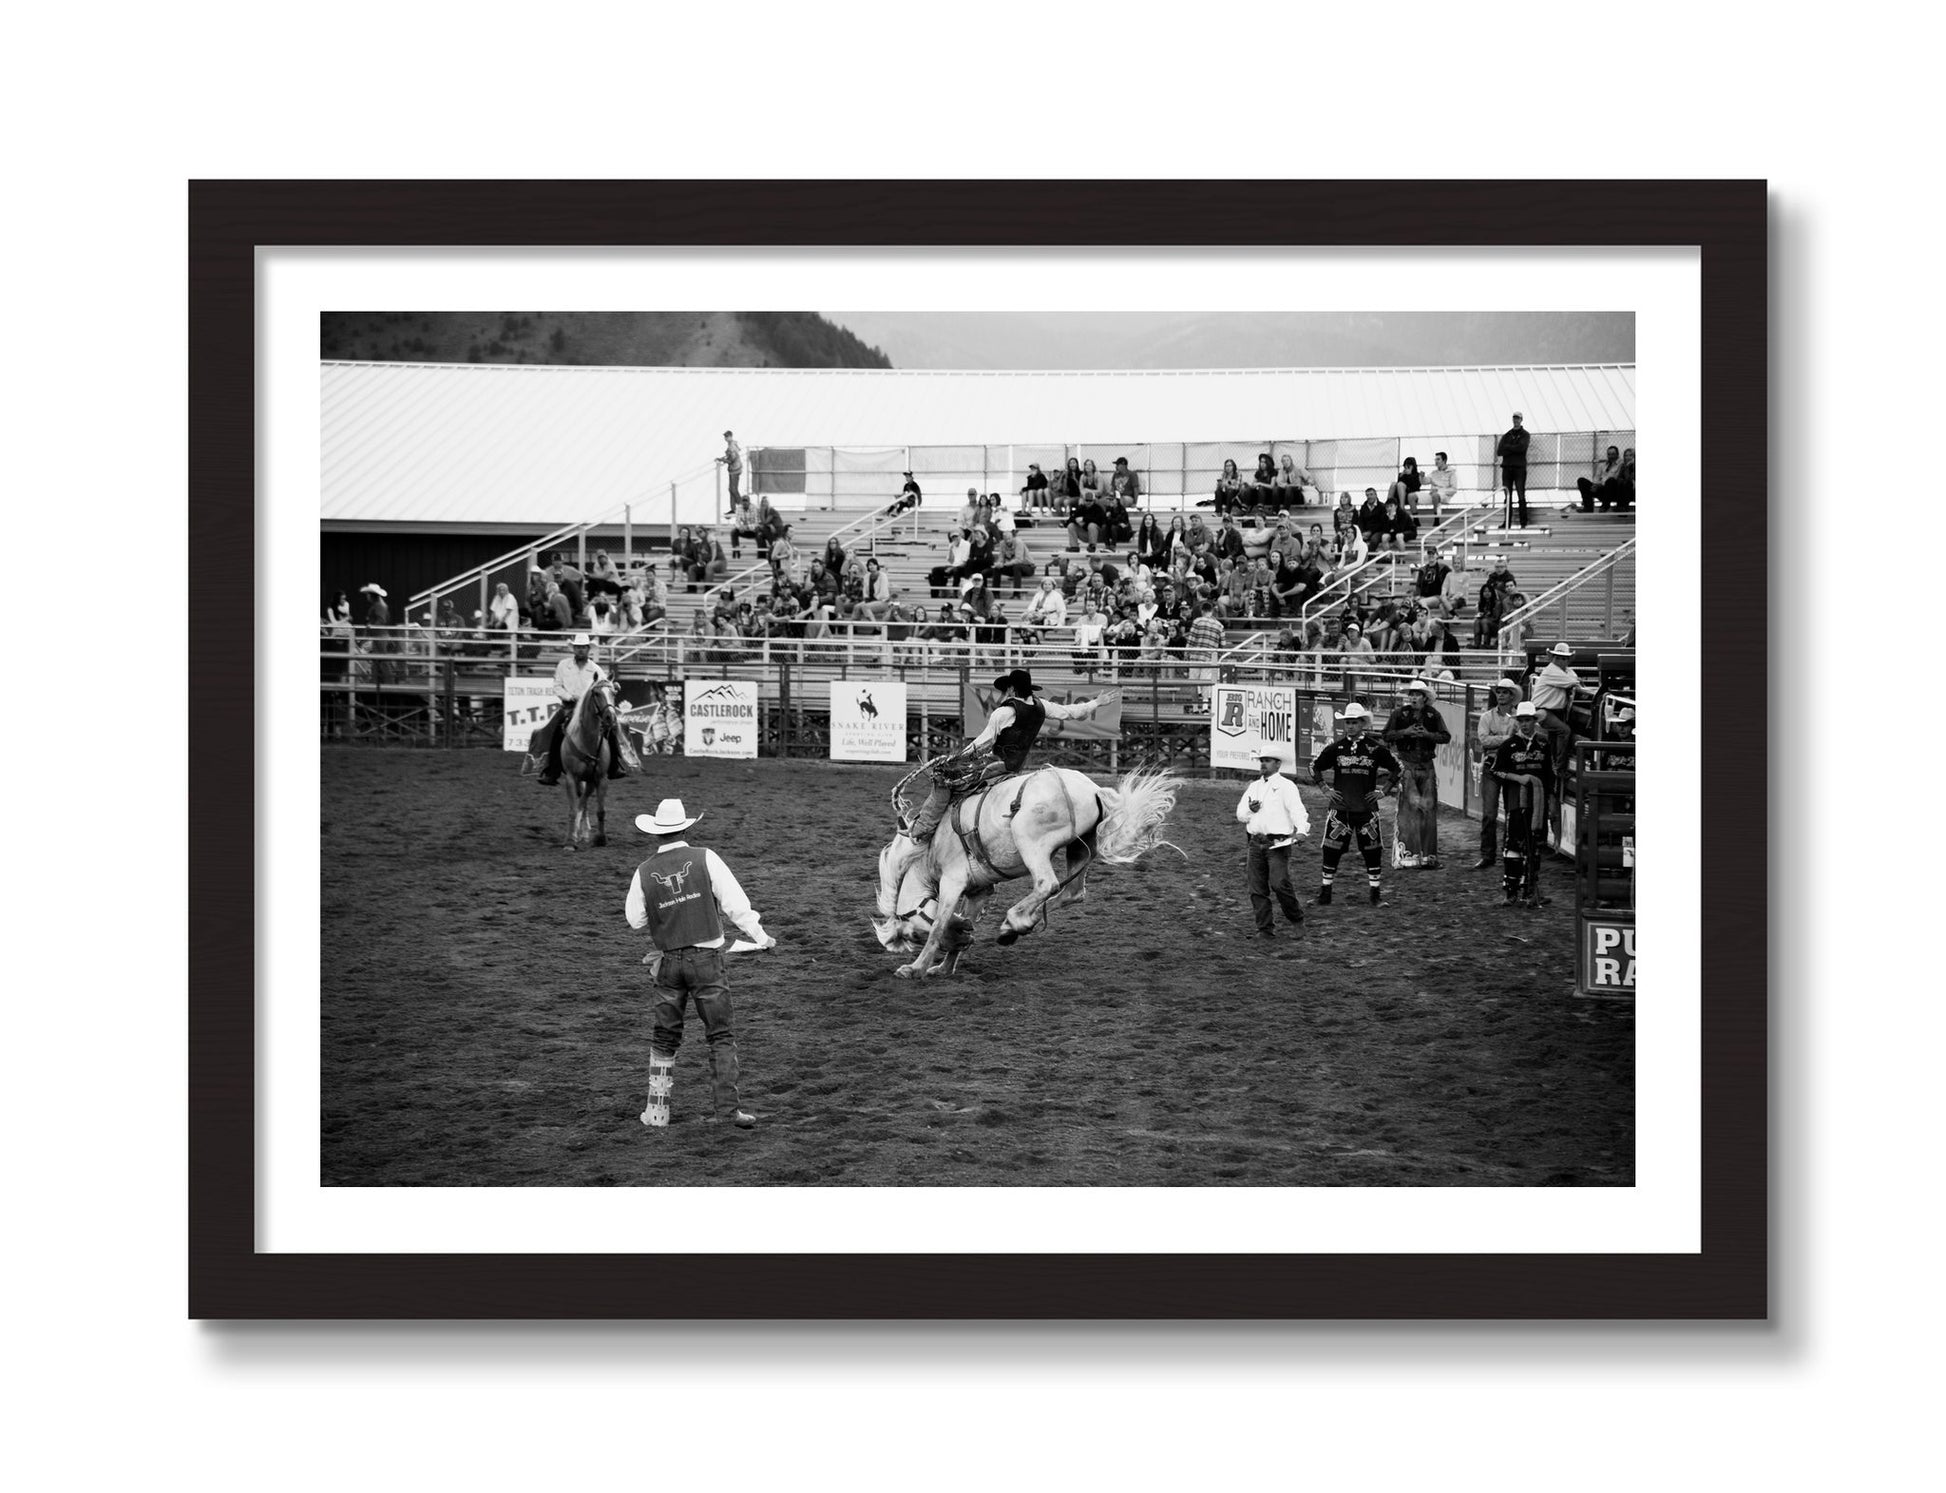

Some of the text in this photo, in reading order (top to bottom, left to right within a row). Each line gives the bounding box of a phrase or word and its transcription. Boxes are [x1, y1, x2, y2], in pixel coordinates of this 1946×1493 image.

[526, 687, 543, 696] TRASH
[1248, 690, 1292, 711] RANCH
[690, 704, 753, 717] CASTLEROCK
[1221, 702, 1244, 727] R
[831, 722, 904, 731] SNAKE RIVER
[1261, 711, 1292, 742] HOME
[719, 732, 742, 744] Jeep
